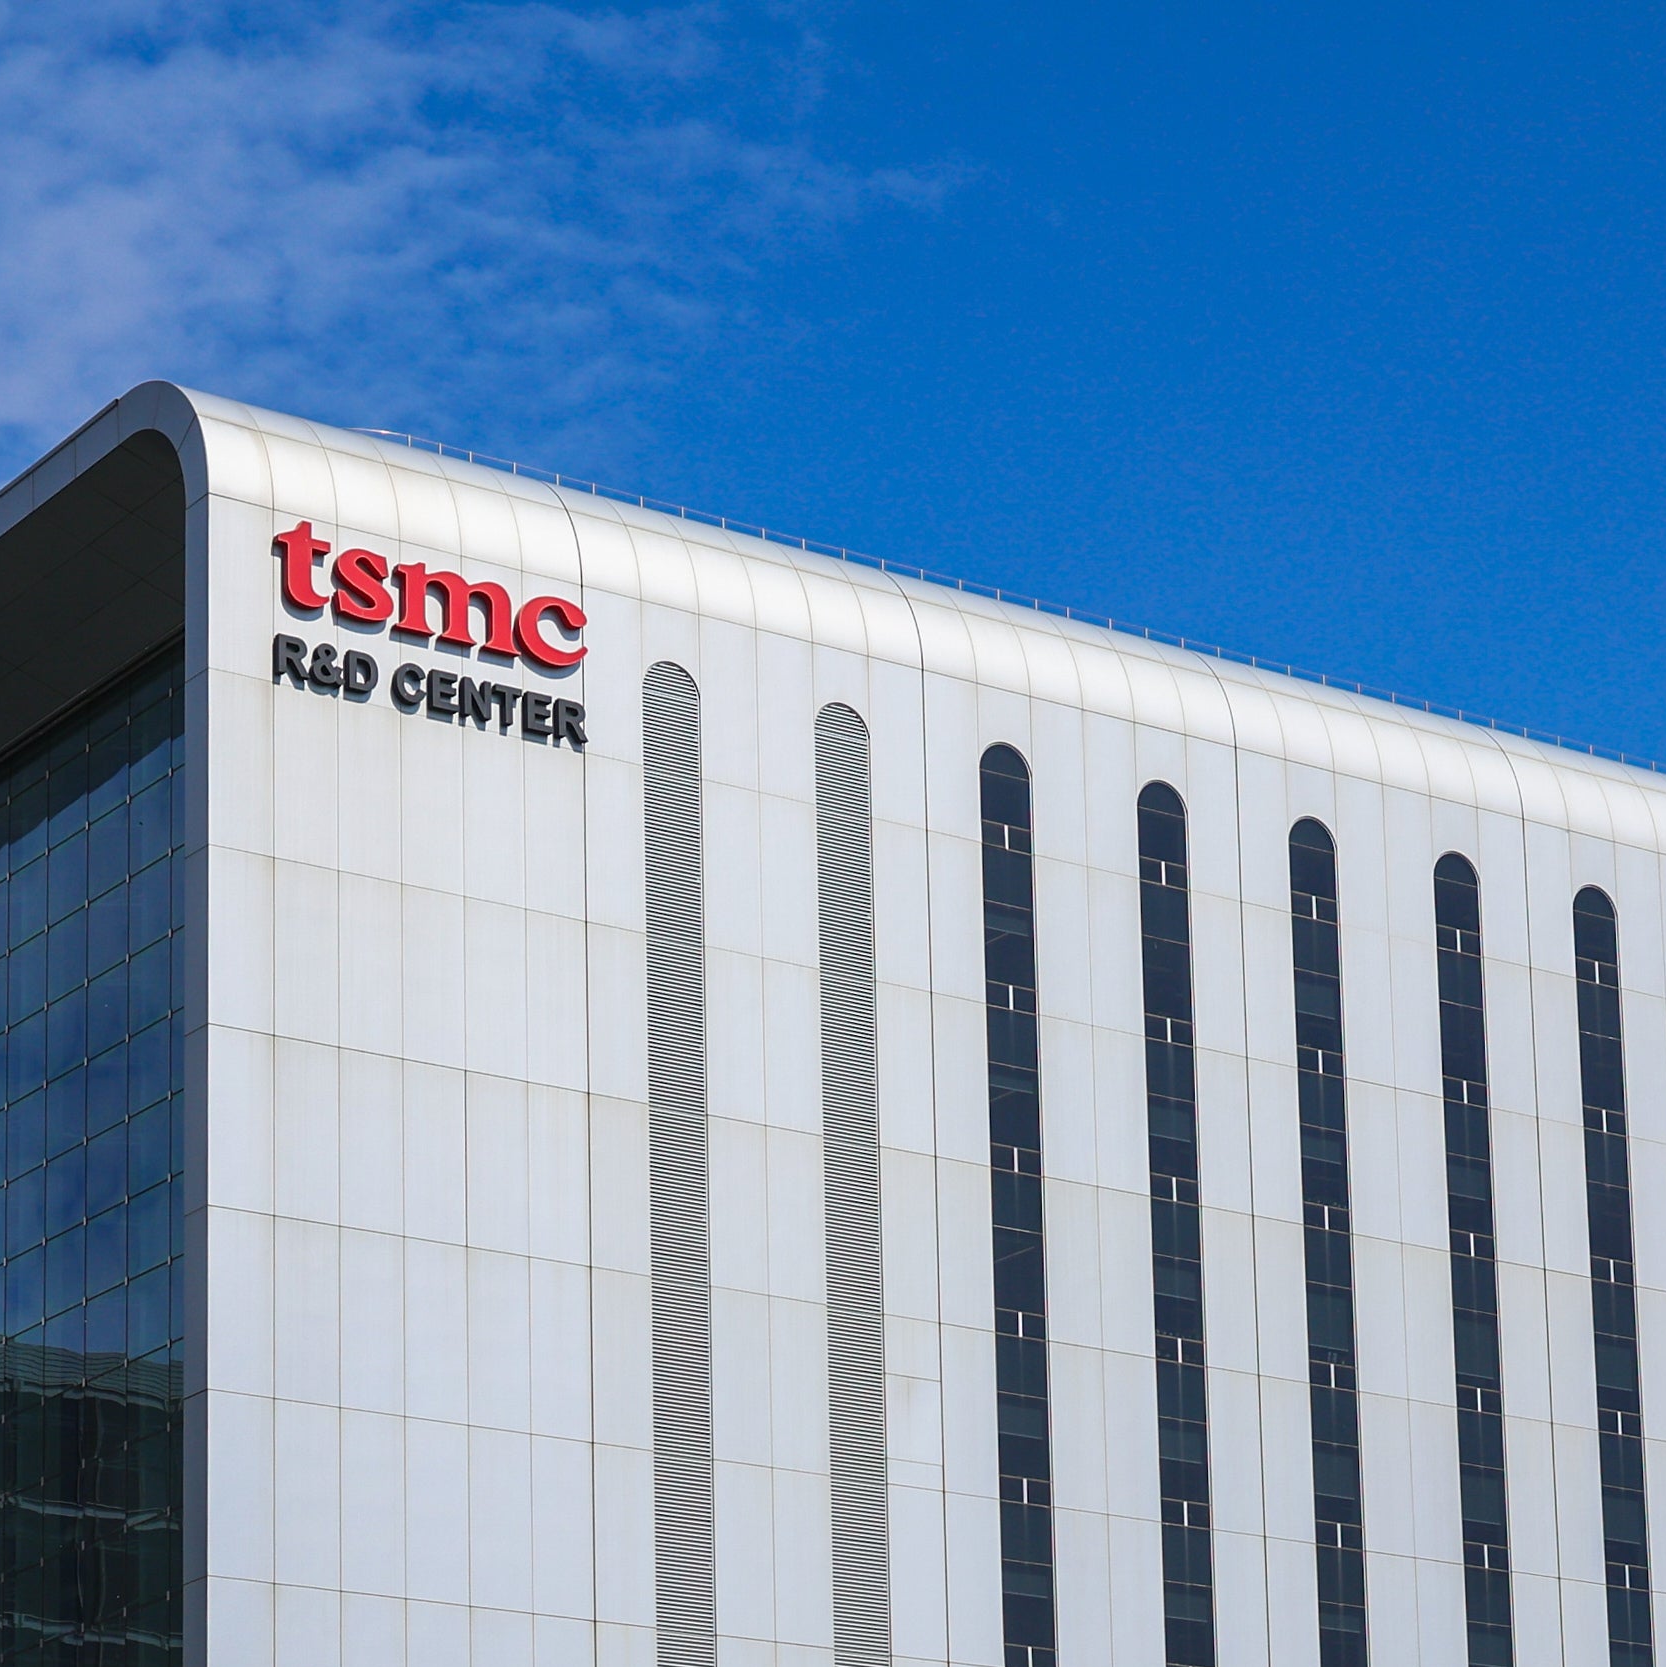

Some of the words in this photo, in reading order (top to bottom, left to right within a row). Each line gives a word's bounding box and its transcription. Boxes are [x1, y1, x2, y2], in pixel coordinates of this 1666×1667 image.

[272, 520, 589, 668] tsmc
[273, 633, 379, 694] R&D
[391, 662, 589, 744] CENTER
